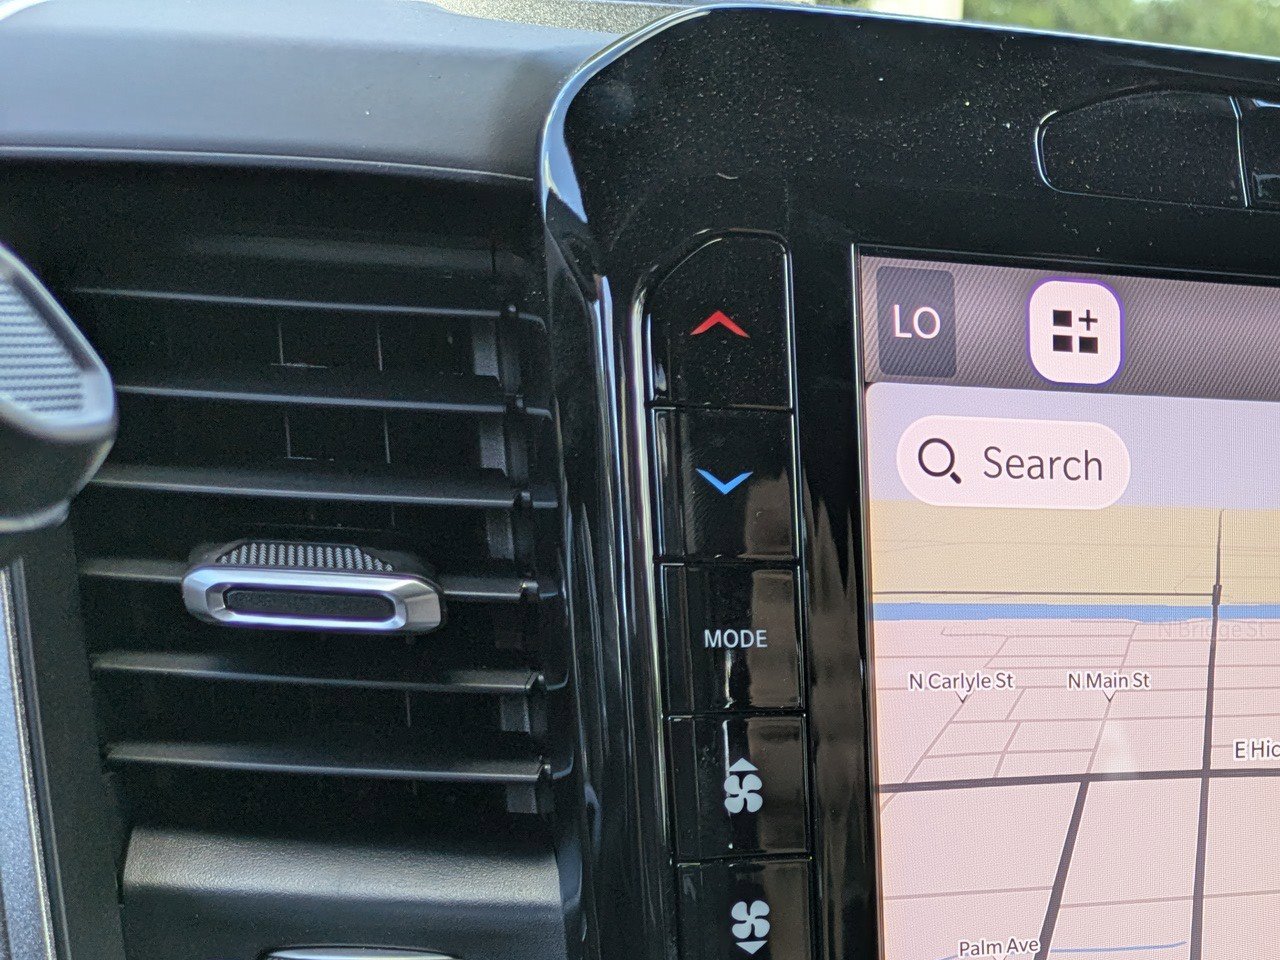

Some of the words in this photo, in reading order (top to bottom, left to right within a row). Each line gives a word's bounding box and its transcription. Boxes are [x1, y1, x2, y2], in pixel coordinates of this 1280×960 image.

[893, 303, 941, 340] LO
[983, 446, 1103, 482] Search
[704, 628, 768, 649] MODE
[909, 674, 924, 689] N
[928, 672, 991, 692] Carlyle
[995, 672, 1014, 688] St
[1068, 673, 1082, 689] N
[1085, 672, 1128, 688] Main
[1132, 672, 1150, 688] St
[1235, 741, 1245, 758] E
[959, 939, 1002, 957] Palm
[1006, 937, 1039, 954] Ave
